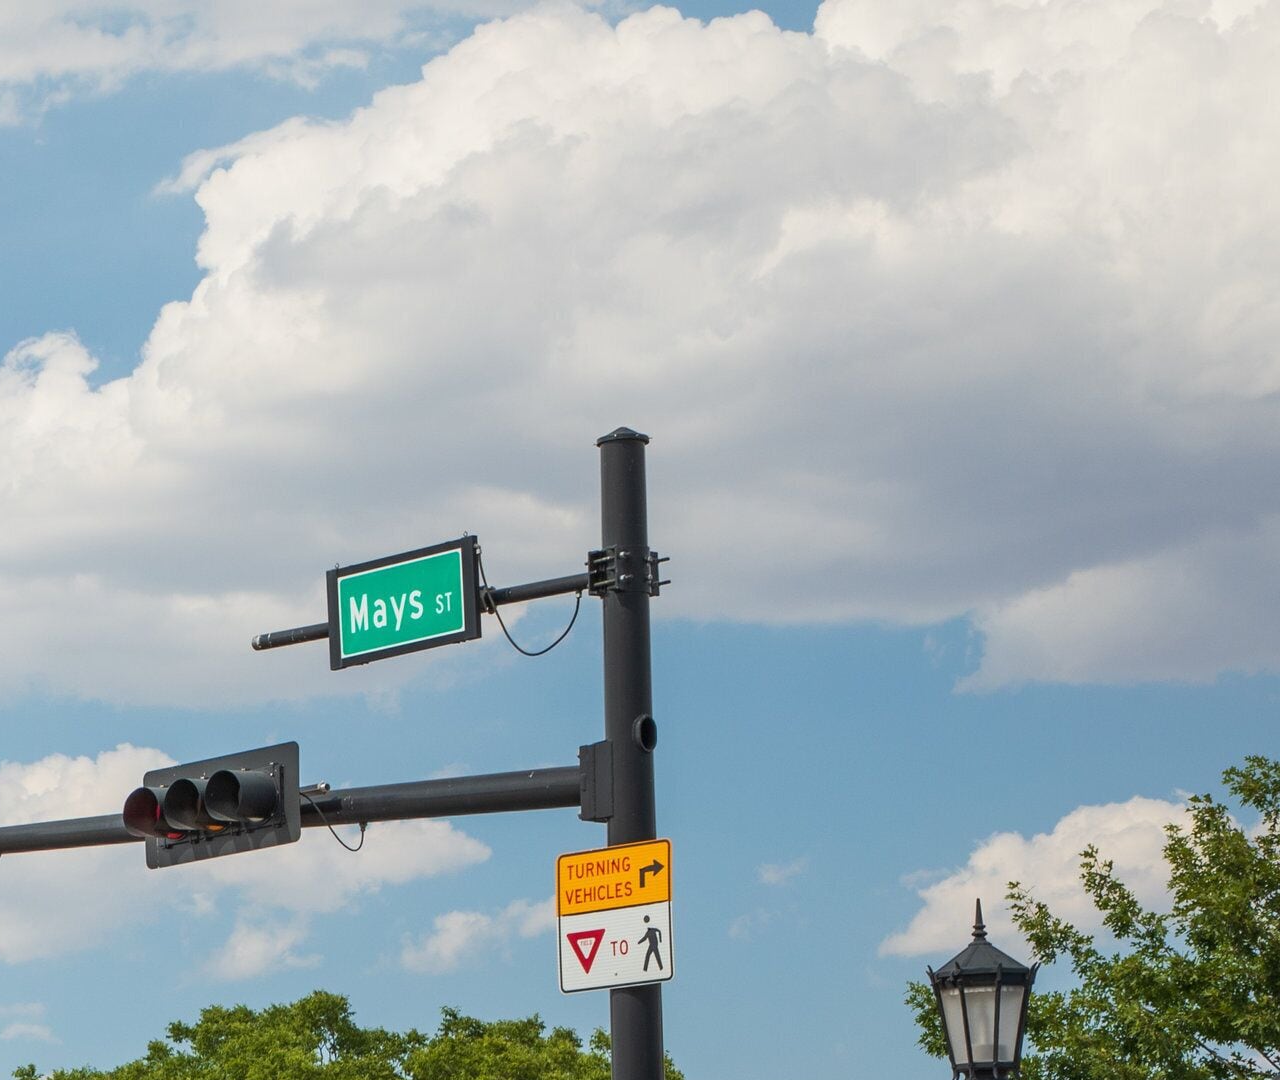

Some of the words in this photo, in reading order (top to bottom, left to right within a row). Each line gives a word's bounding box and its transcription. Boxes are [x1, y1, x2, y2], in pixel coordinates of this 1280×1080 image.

[349, 590, 424, 634] Mays
[435, 591, 453, 615] ST
[567, 856, 631, 881] TURNING
[565, 881, 633, 905] VEHICLES
[610, 939, 629, 956] TO
